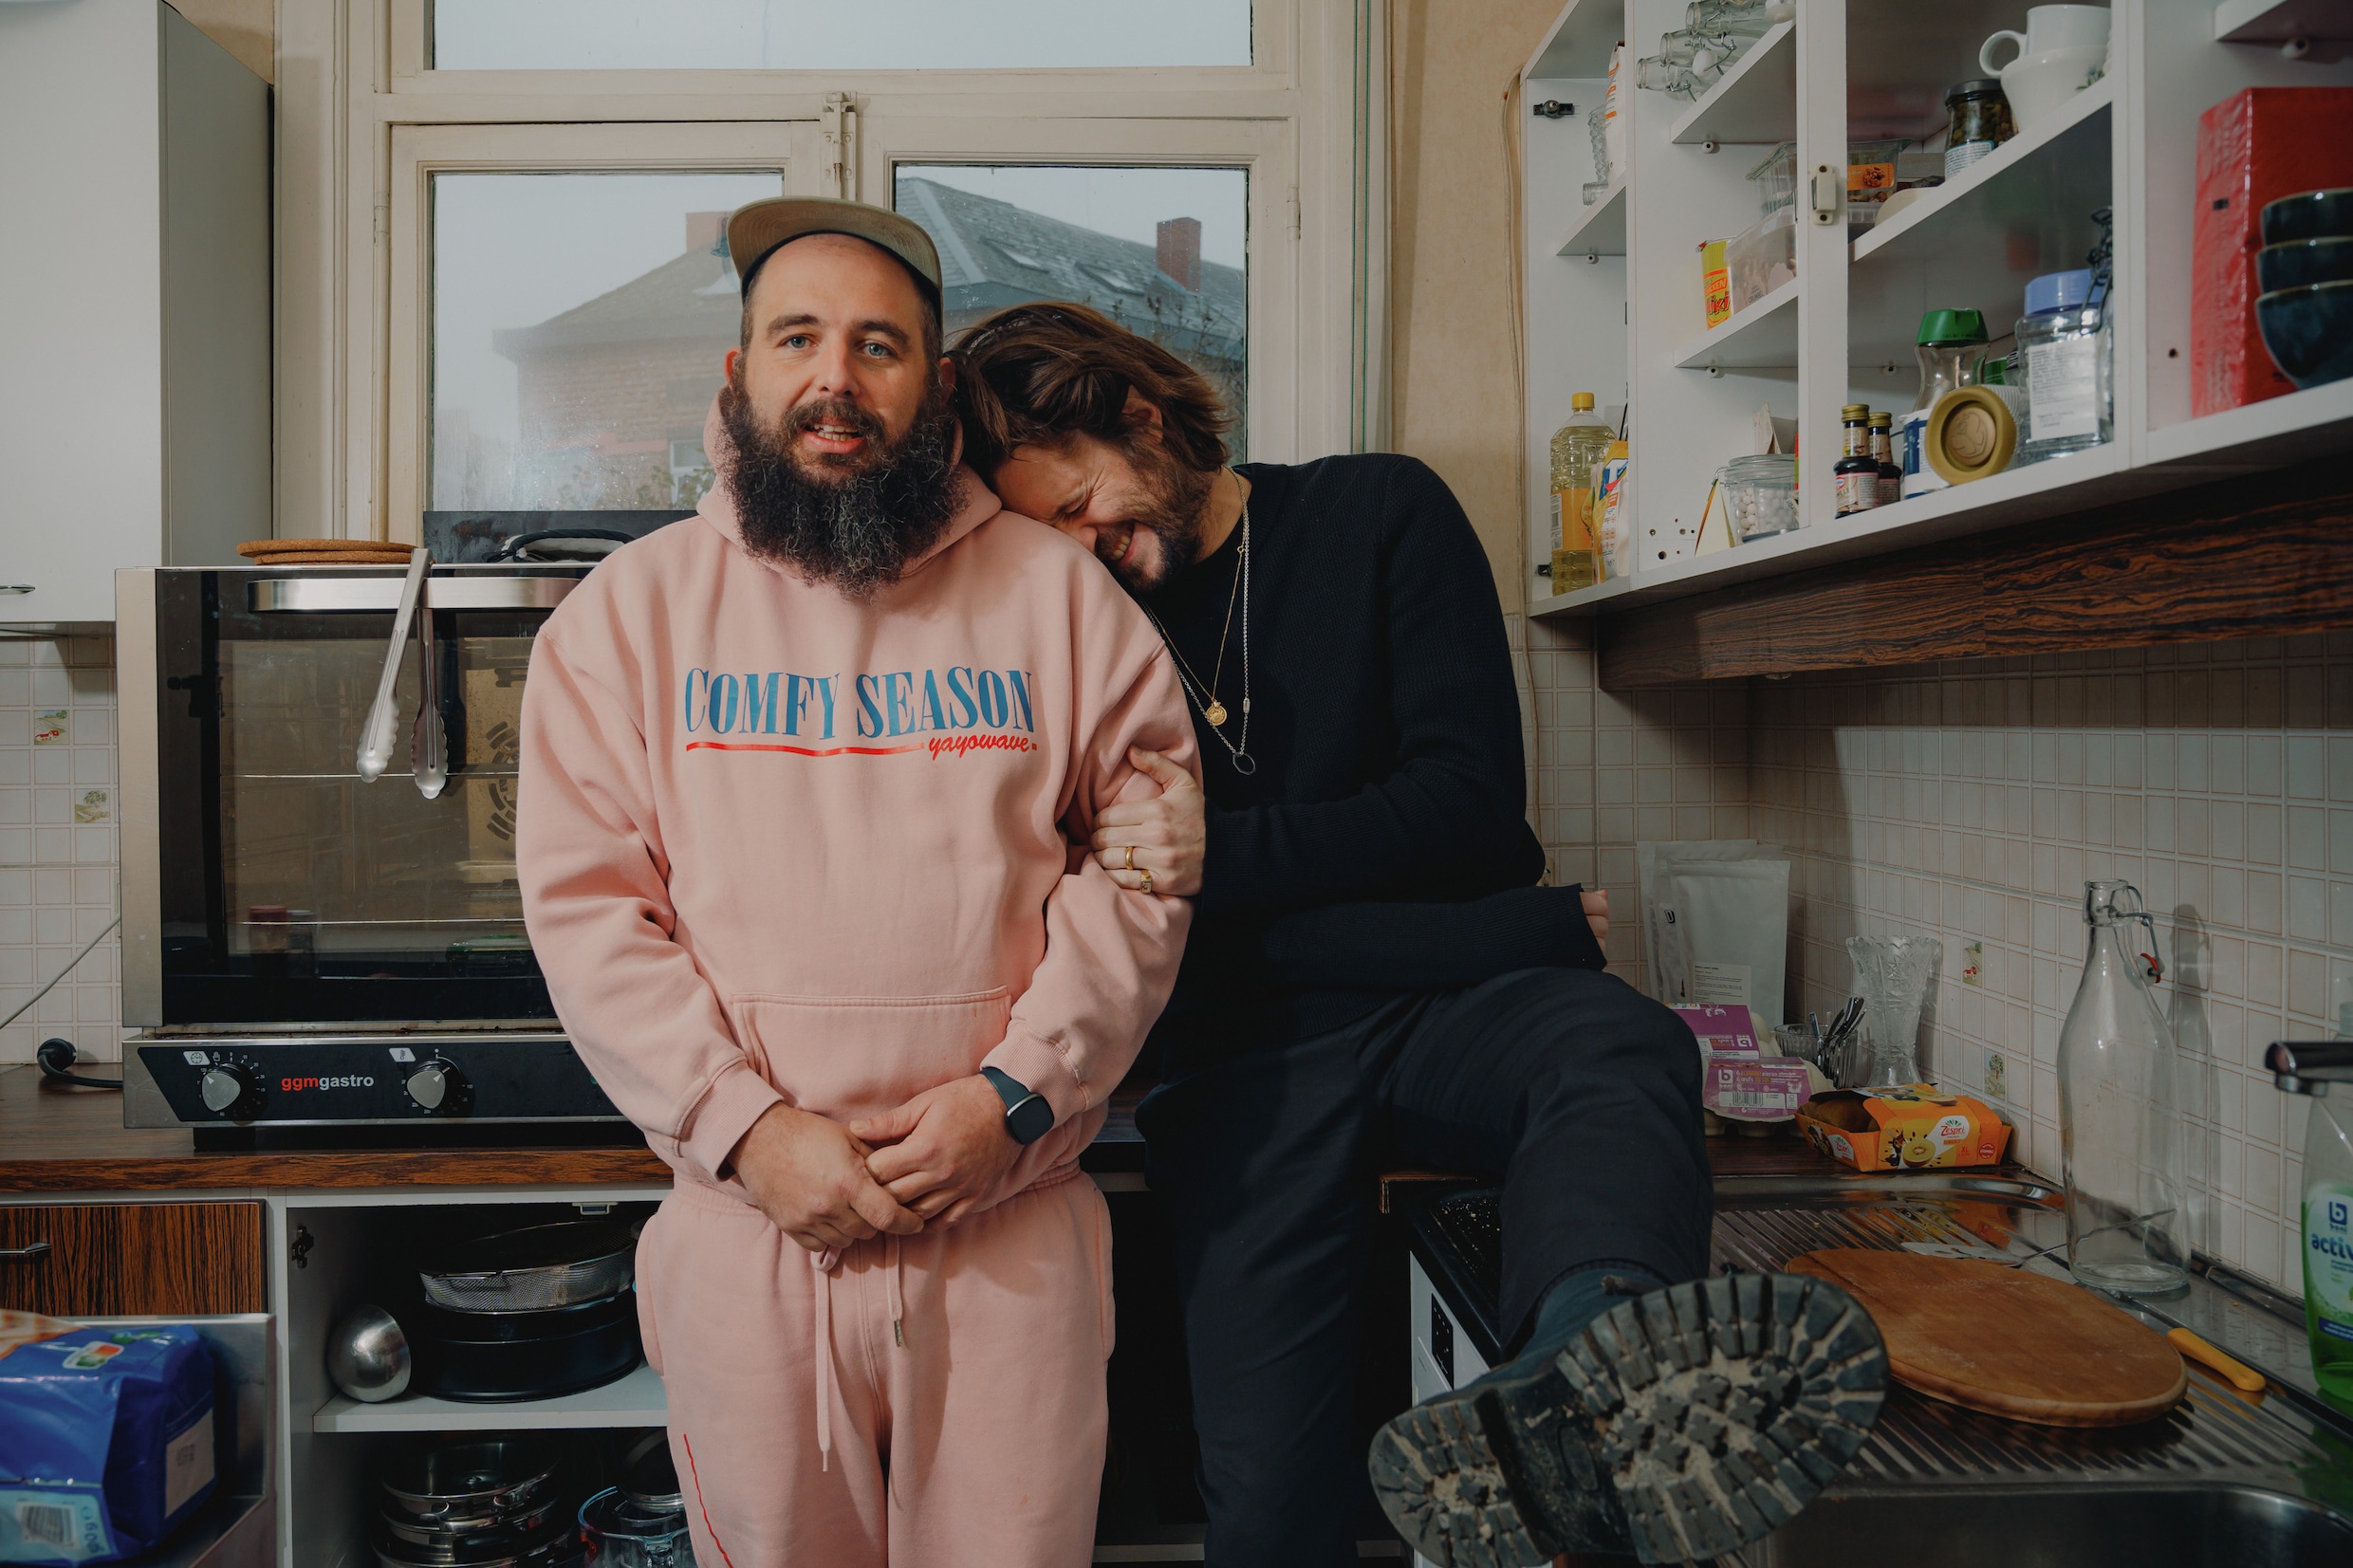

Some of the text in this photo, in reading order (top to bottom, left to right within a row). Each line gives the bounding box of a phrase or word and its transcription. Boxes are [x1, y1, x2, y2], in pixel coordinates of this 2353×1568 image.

[685, 666, 1034, 740] COMFY SEASON
[1940, 1125, 1965, 1136] Zespri
